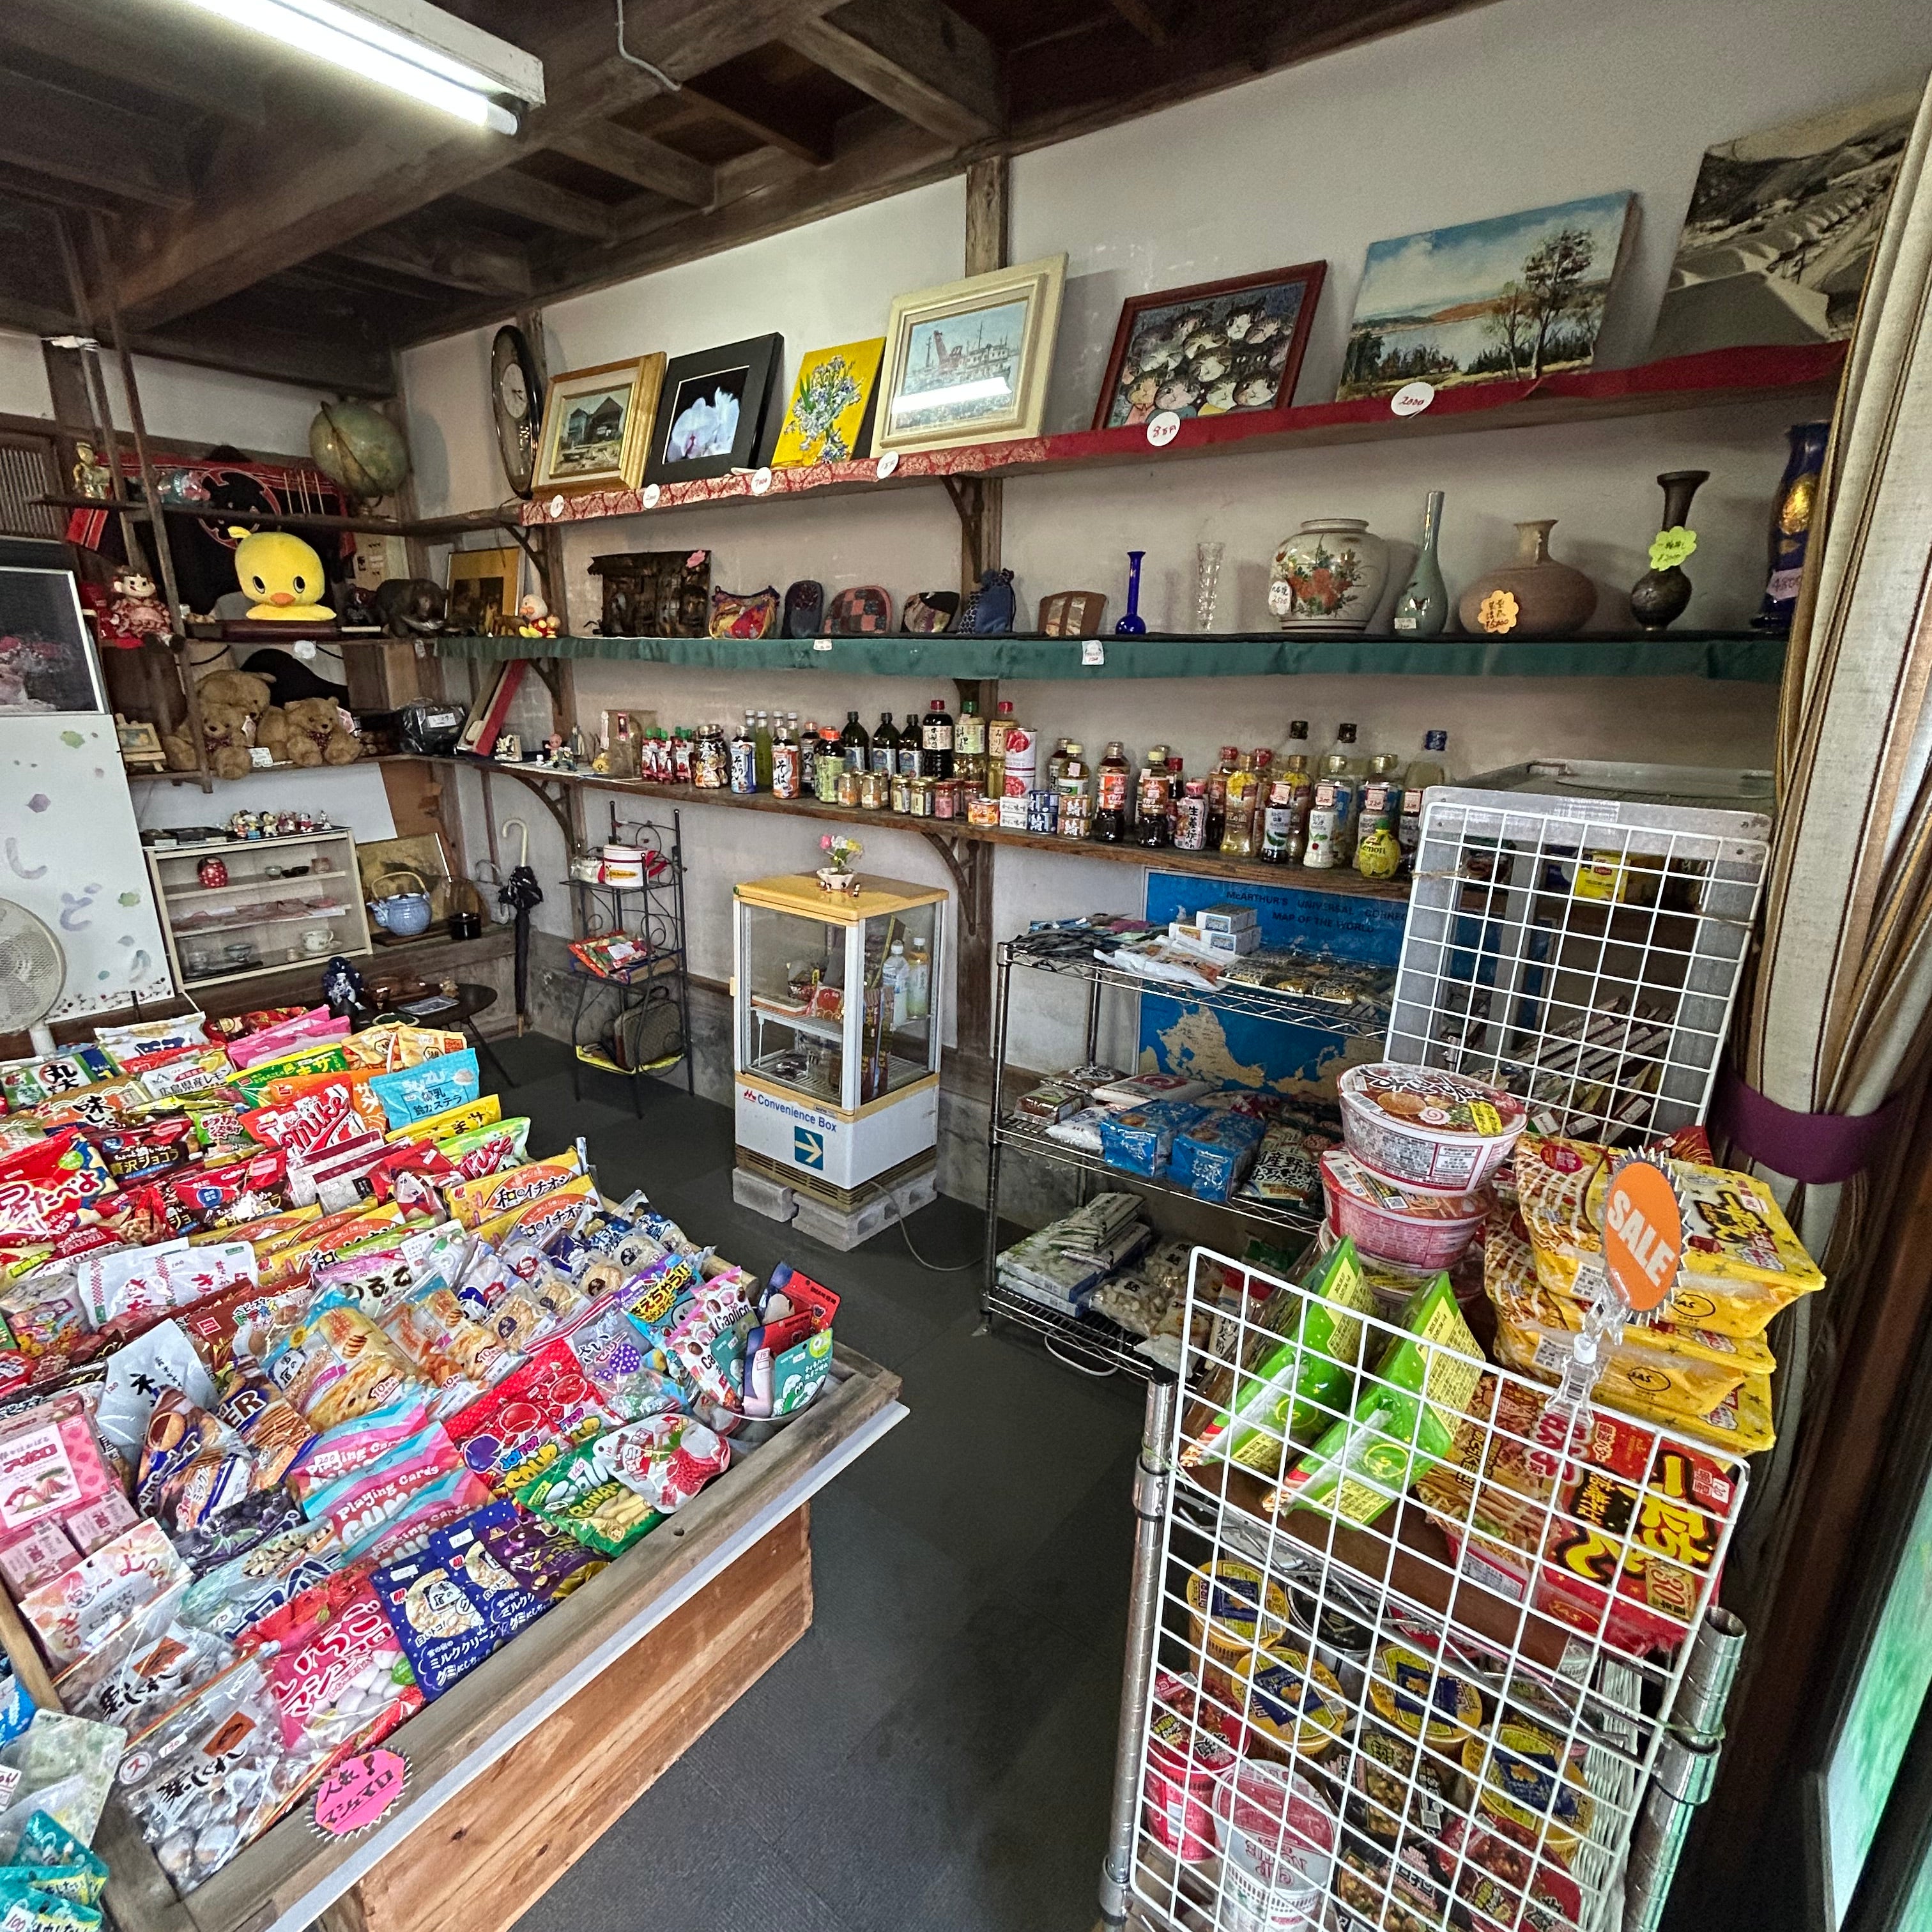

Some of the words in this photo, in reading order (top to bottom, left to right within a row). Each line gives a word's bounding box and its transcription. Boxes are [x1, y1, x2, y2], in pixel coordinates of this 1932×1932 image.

[1272, 912, 1296, 922] MAP
[1298, 916, 1310, 924] OF
[1315, 917, 1333, 926] THE
[1337, 920, 1374, 933] WORLD
[158, 1065, 233, 1097] 広島県産レモン
[757, 1094, 816, 1124] Convenience
[818, 1116, 837, 1132] Box
[1607, 1190, 1676, 1287] SALE
[398, 1466, 440, 1486] Cards
[321, 1768, 394, 1825] マシュマロ
